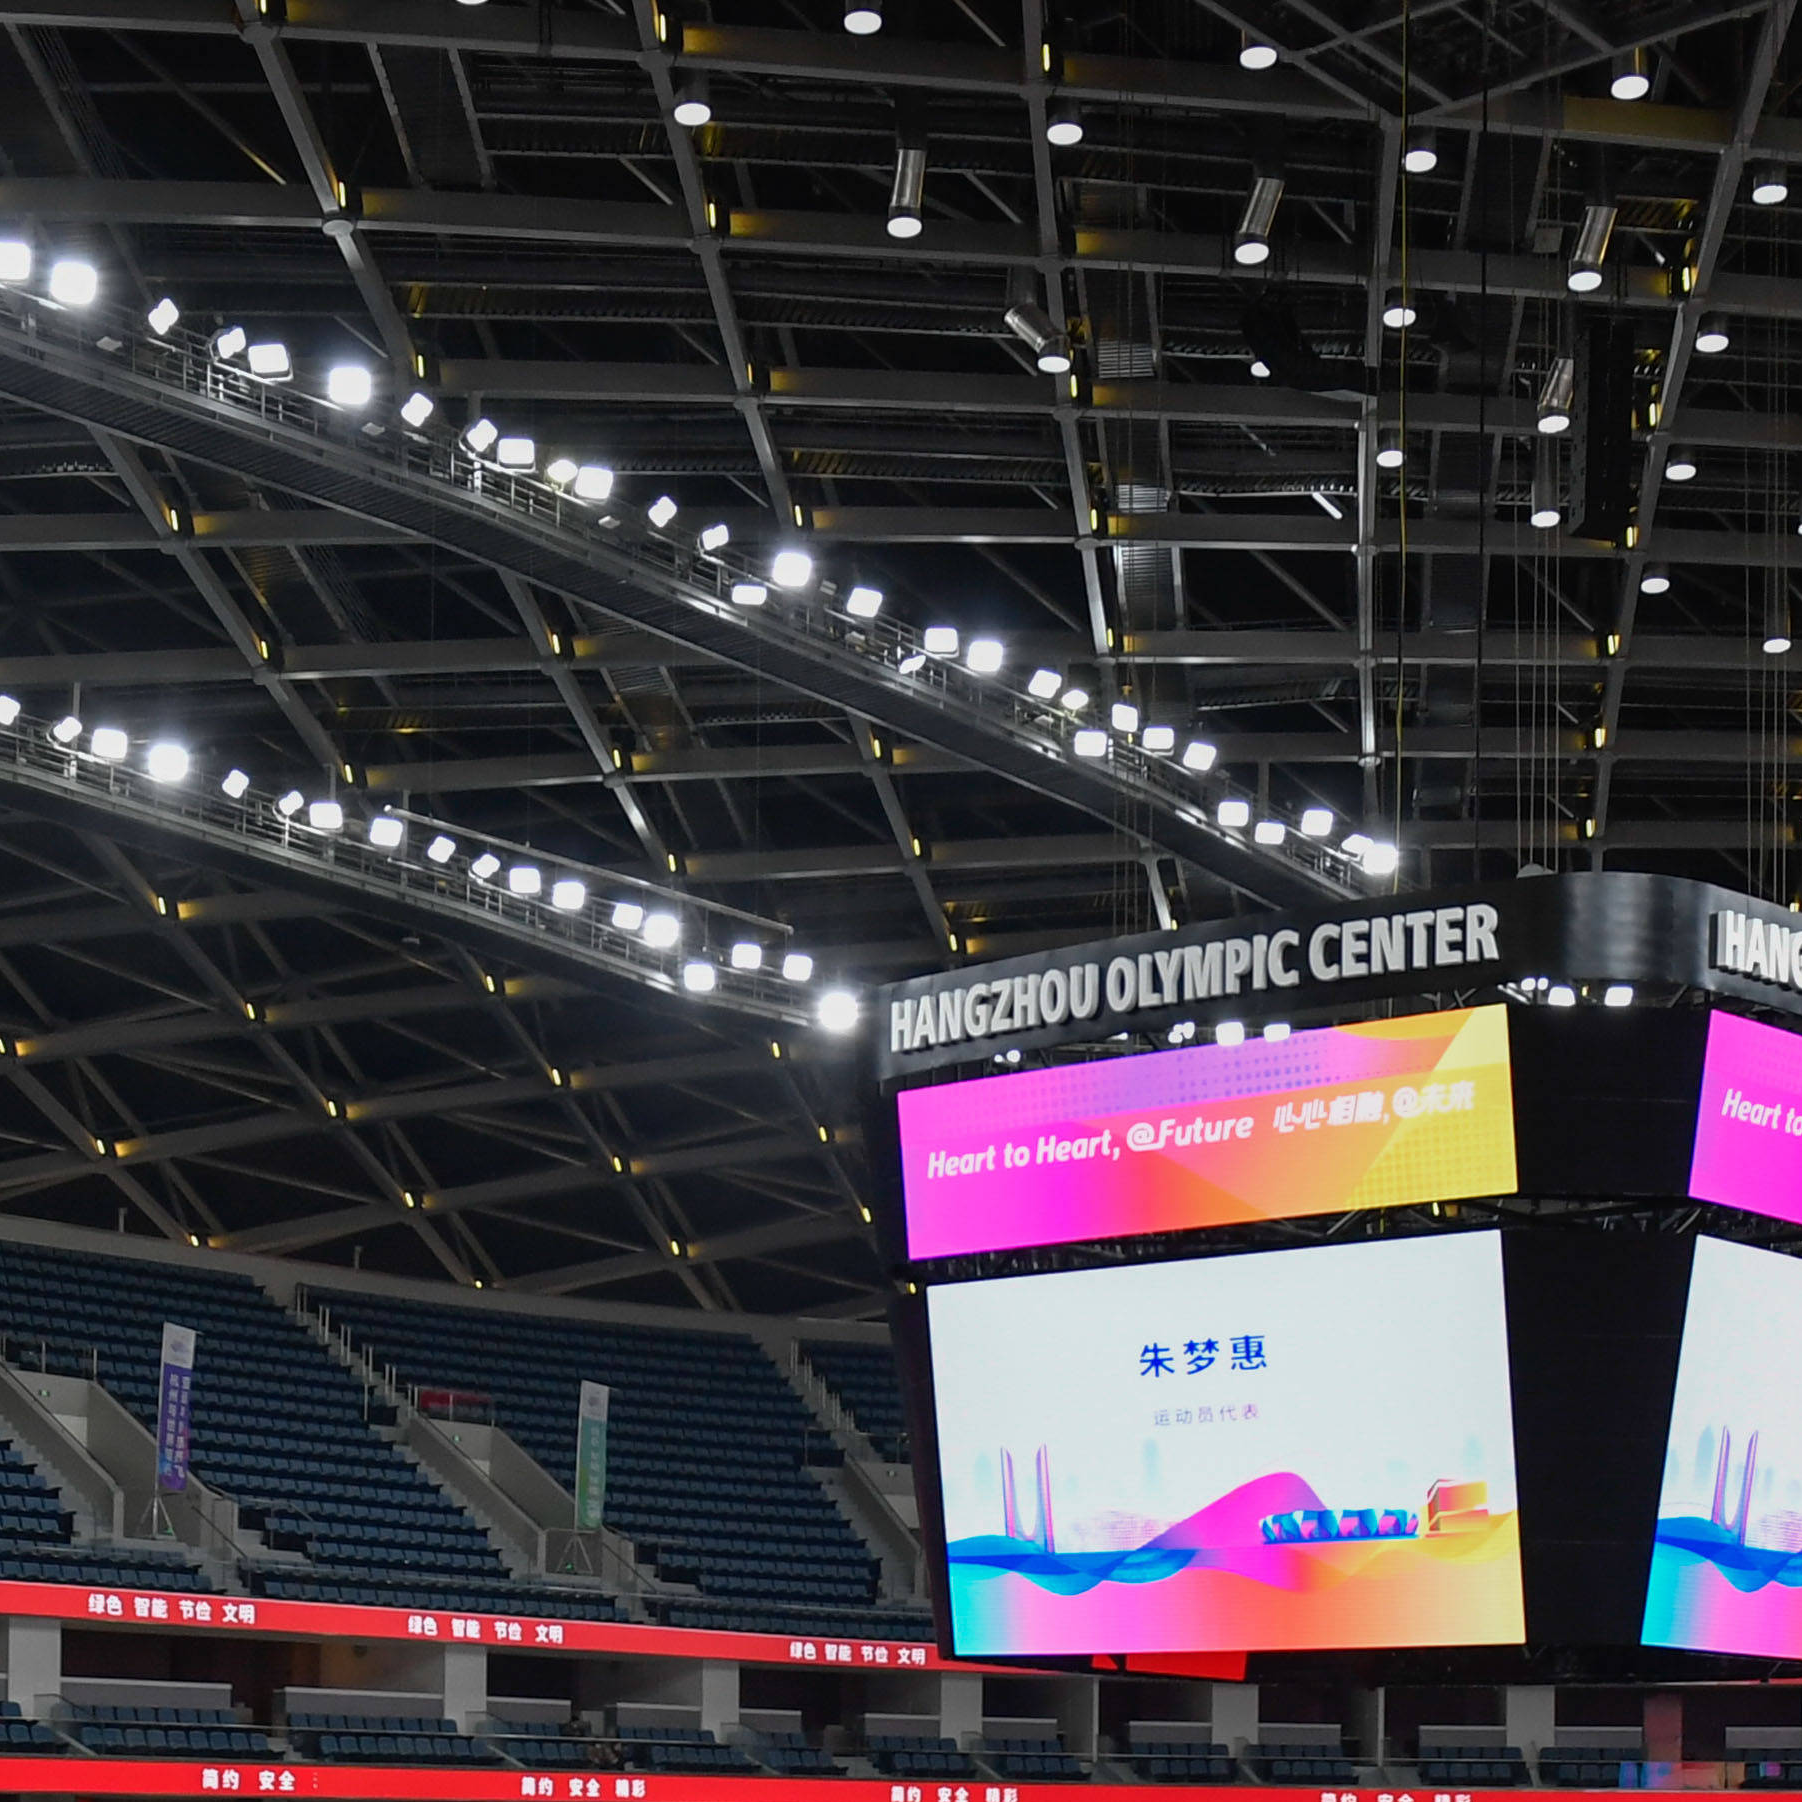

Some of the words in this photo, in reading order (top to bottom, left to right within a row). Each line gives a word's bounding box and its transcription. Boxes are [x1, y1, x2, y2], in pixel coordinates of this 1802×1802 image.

[891, 963, 1099, 1053] HANGZHOU
[1106, 928, 1300, 1012] OLYMPIC
[1309, 902, 1500, 982] CENTER
[1721, 1088, 1782, 1130] Heart
[927, 1146, 995, 1179] Heart
[1004, 1142, 1030, 1168] to
[1036, 1129, 1121, 1164] Heart,
[1126, 1116, 1255, 1152] @Future
[1139, 1334, 1267, 1378] 朱梦惠
[1153, 1403, 1259, 1426] 运动员代表
[88, 1594, 123, 1617] 绿色
[134, 1597, 168, 1620] 智能
[222, 1603, 255, 1625] 文明
[536, 1624, 563, 1644] 文明
[897, 1647, 926, 1666] 文明
[202, 1768, 240, 1790] 简约
[259, 1770, 295, 1791] 安全
[521, 1776, 553, 1797] 简约
[569, 1778, 600, 1798] 安全
[615, 1779, 646, 1798] 精彩
